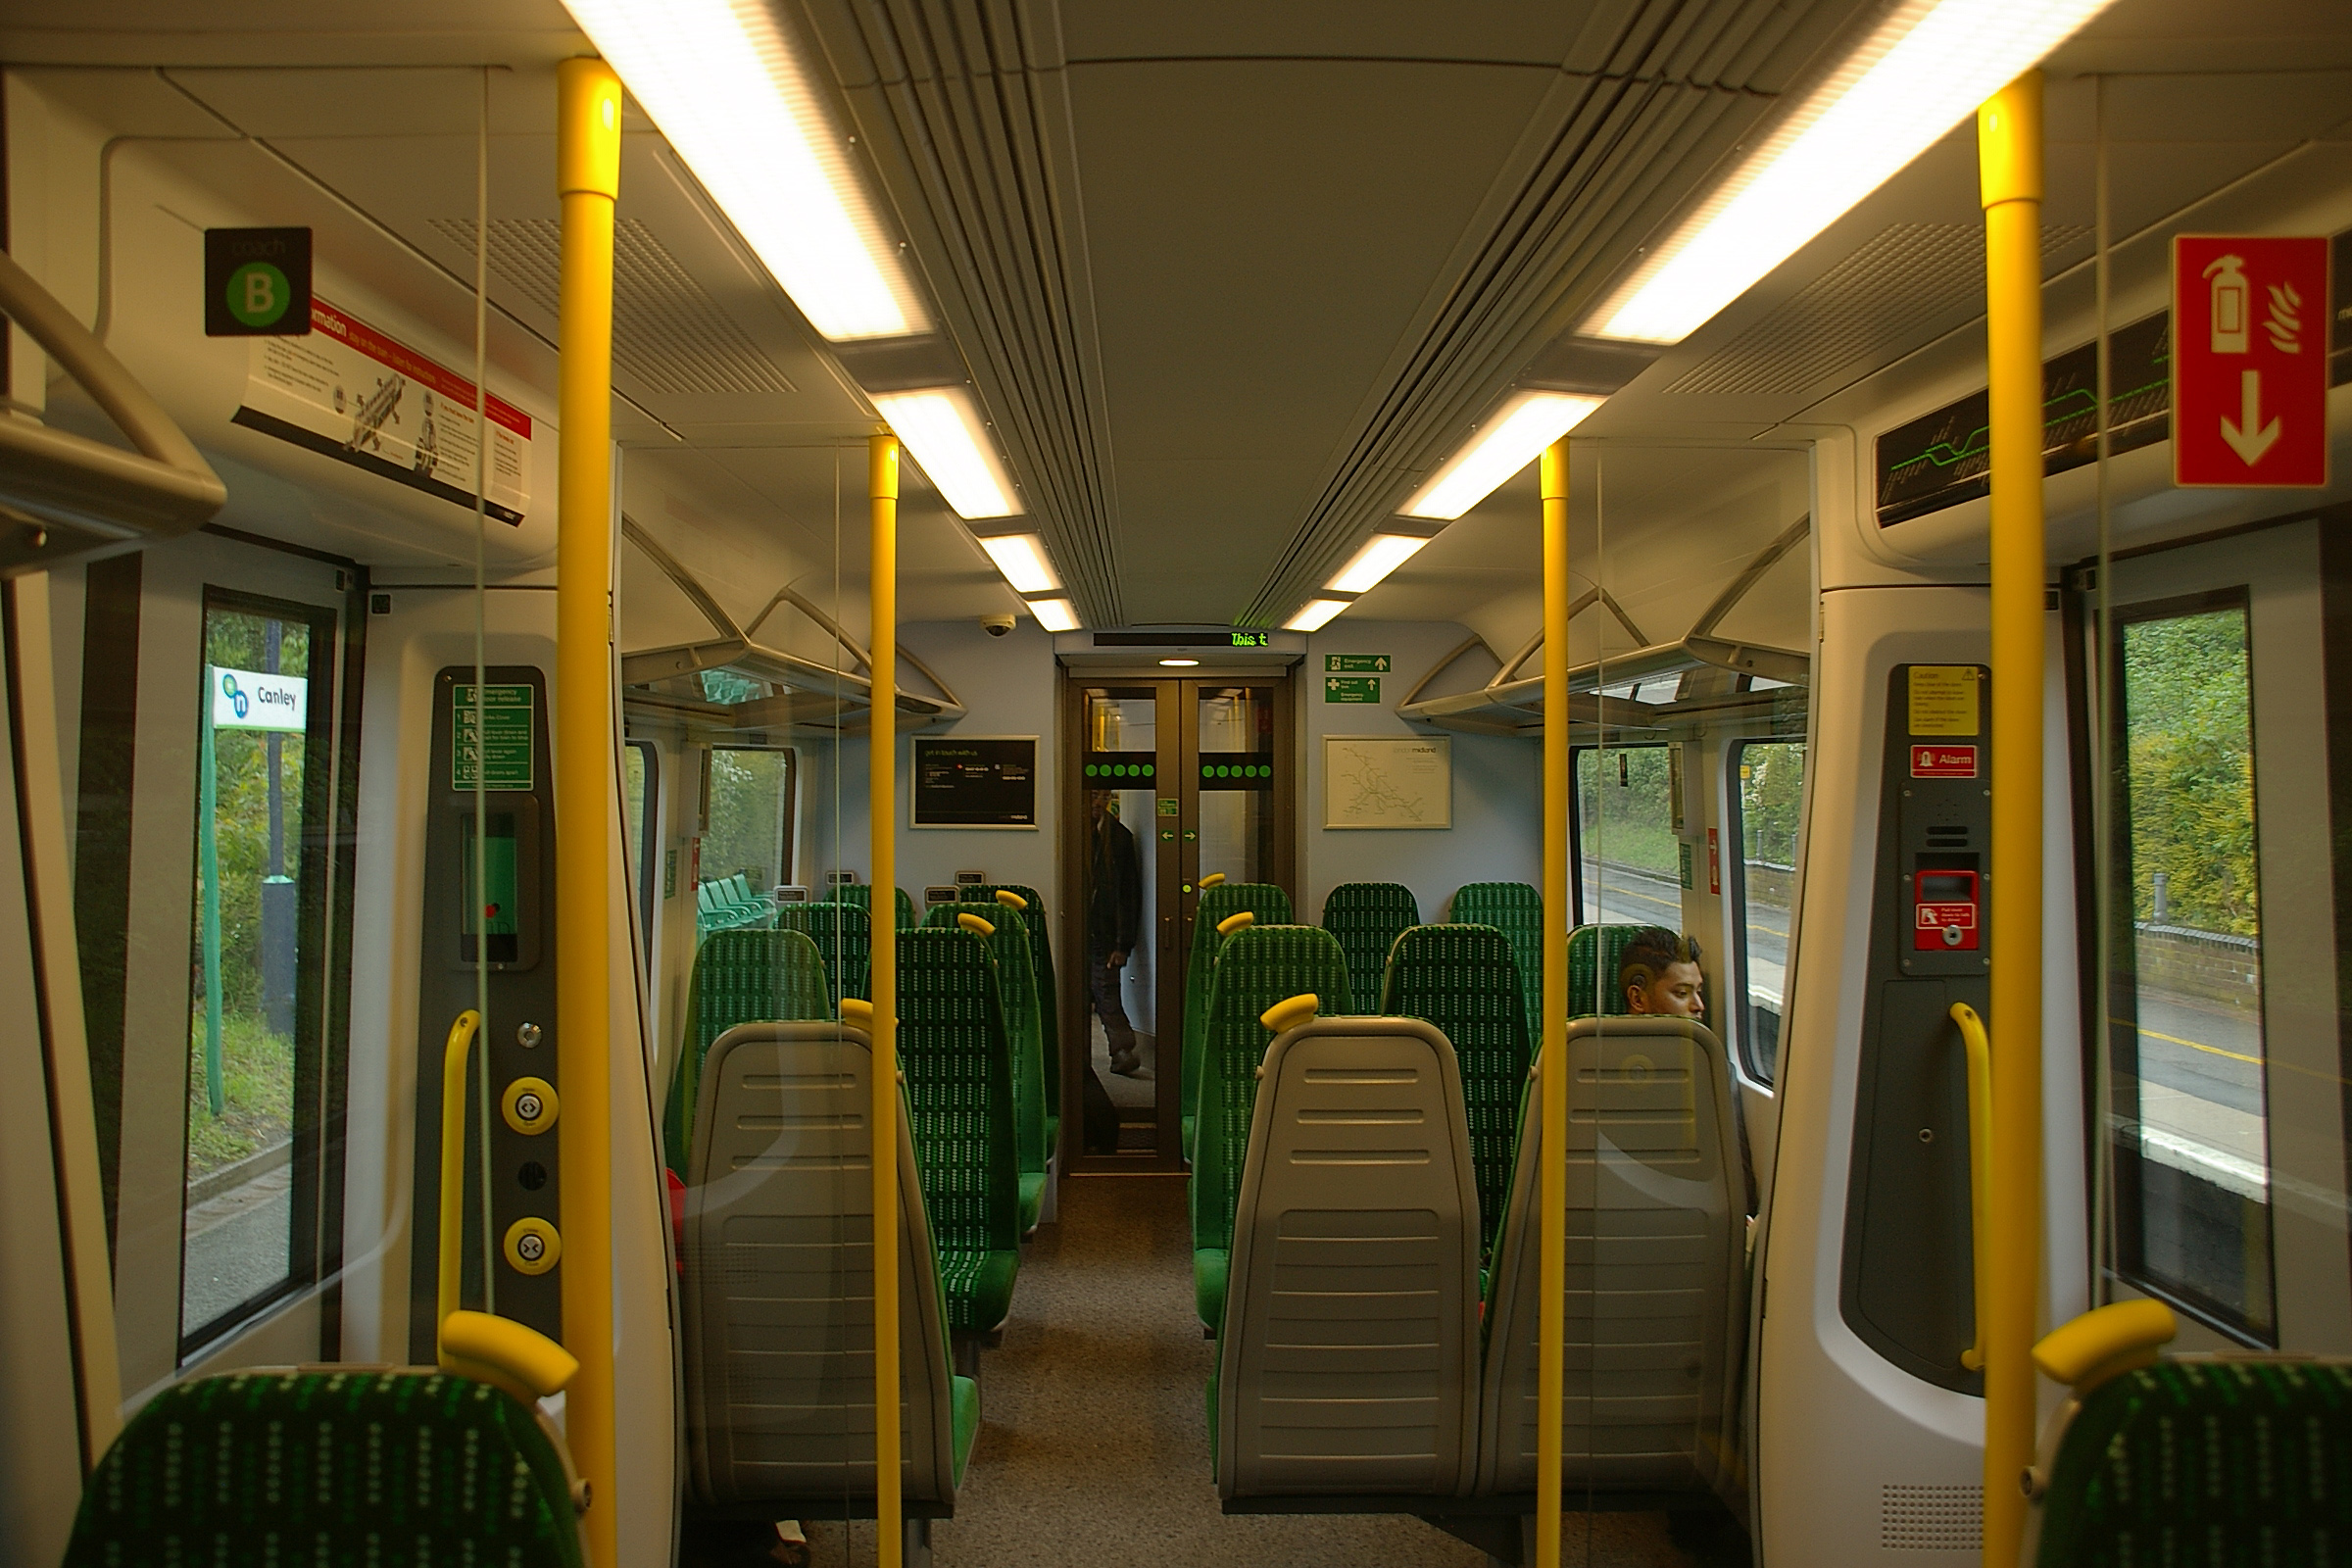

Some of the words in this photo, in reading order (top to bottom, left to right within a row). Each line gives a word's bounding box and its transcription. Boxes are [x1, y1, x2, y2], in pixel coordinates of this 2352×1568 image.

[245, 271, 273, 313] B
[312, 307, 348, 338] rmation
[1231, 632, 1257, 647] This
[1258, 632, 1269, 647] t
[257, 686, 297, 711] Canley
[1938, 754, 1973, 764] Alarm
